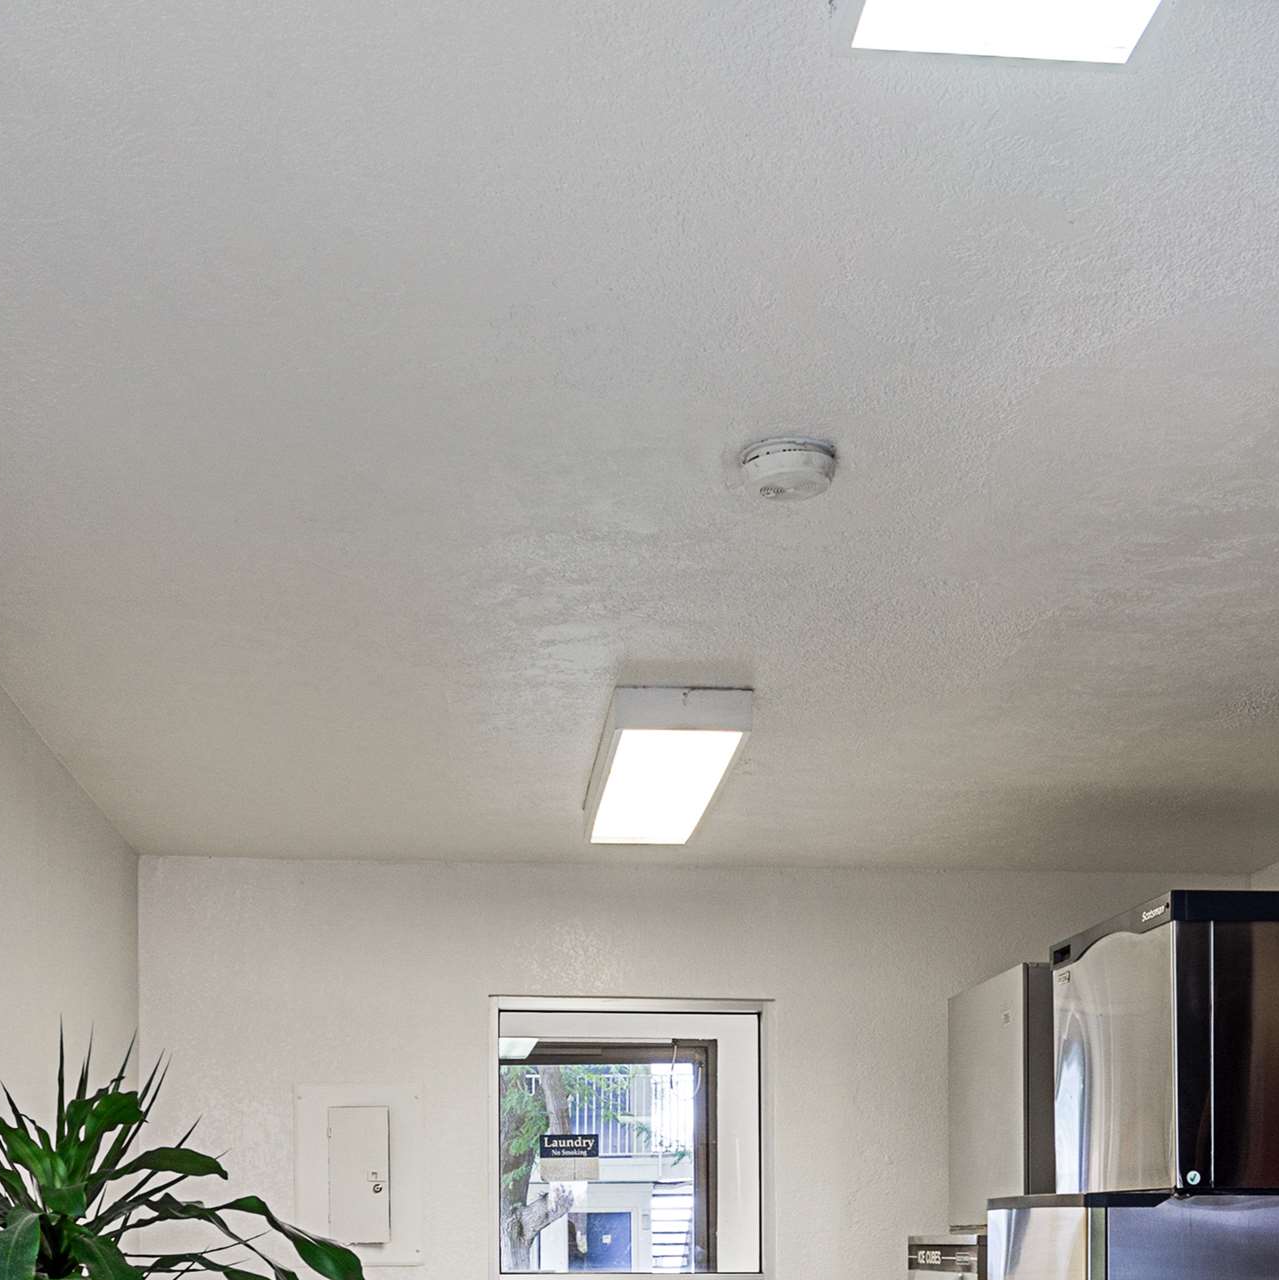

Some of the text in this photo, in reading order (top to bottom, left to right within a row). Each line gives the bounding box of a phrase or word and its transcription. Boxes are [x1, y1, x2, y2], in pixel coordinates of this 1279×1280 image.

[1141, 905, 1166, 922] Scotsman
[544, 1136, 595, 1150] Laundry
[918, 1250, 926, 1264] ICE
[926, 1250, 941, 1264] CUBES
